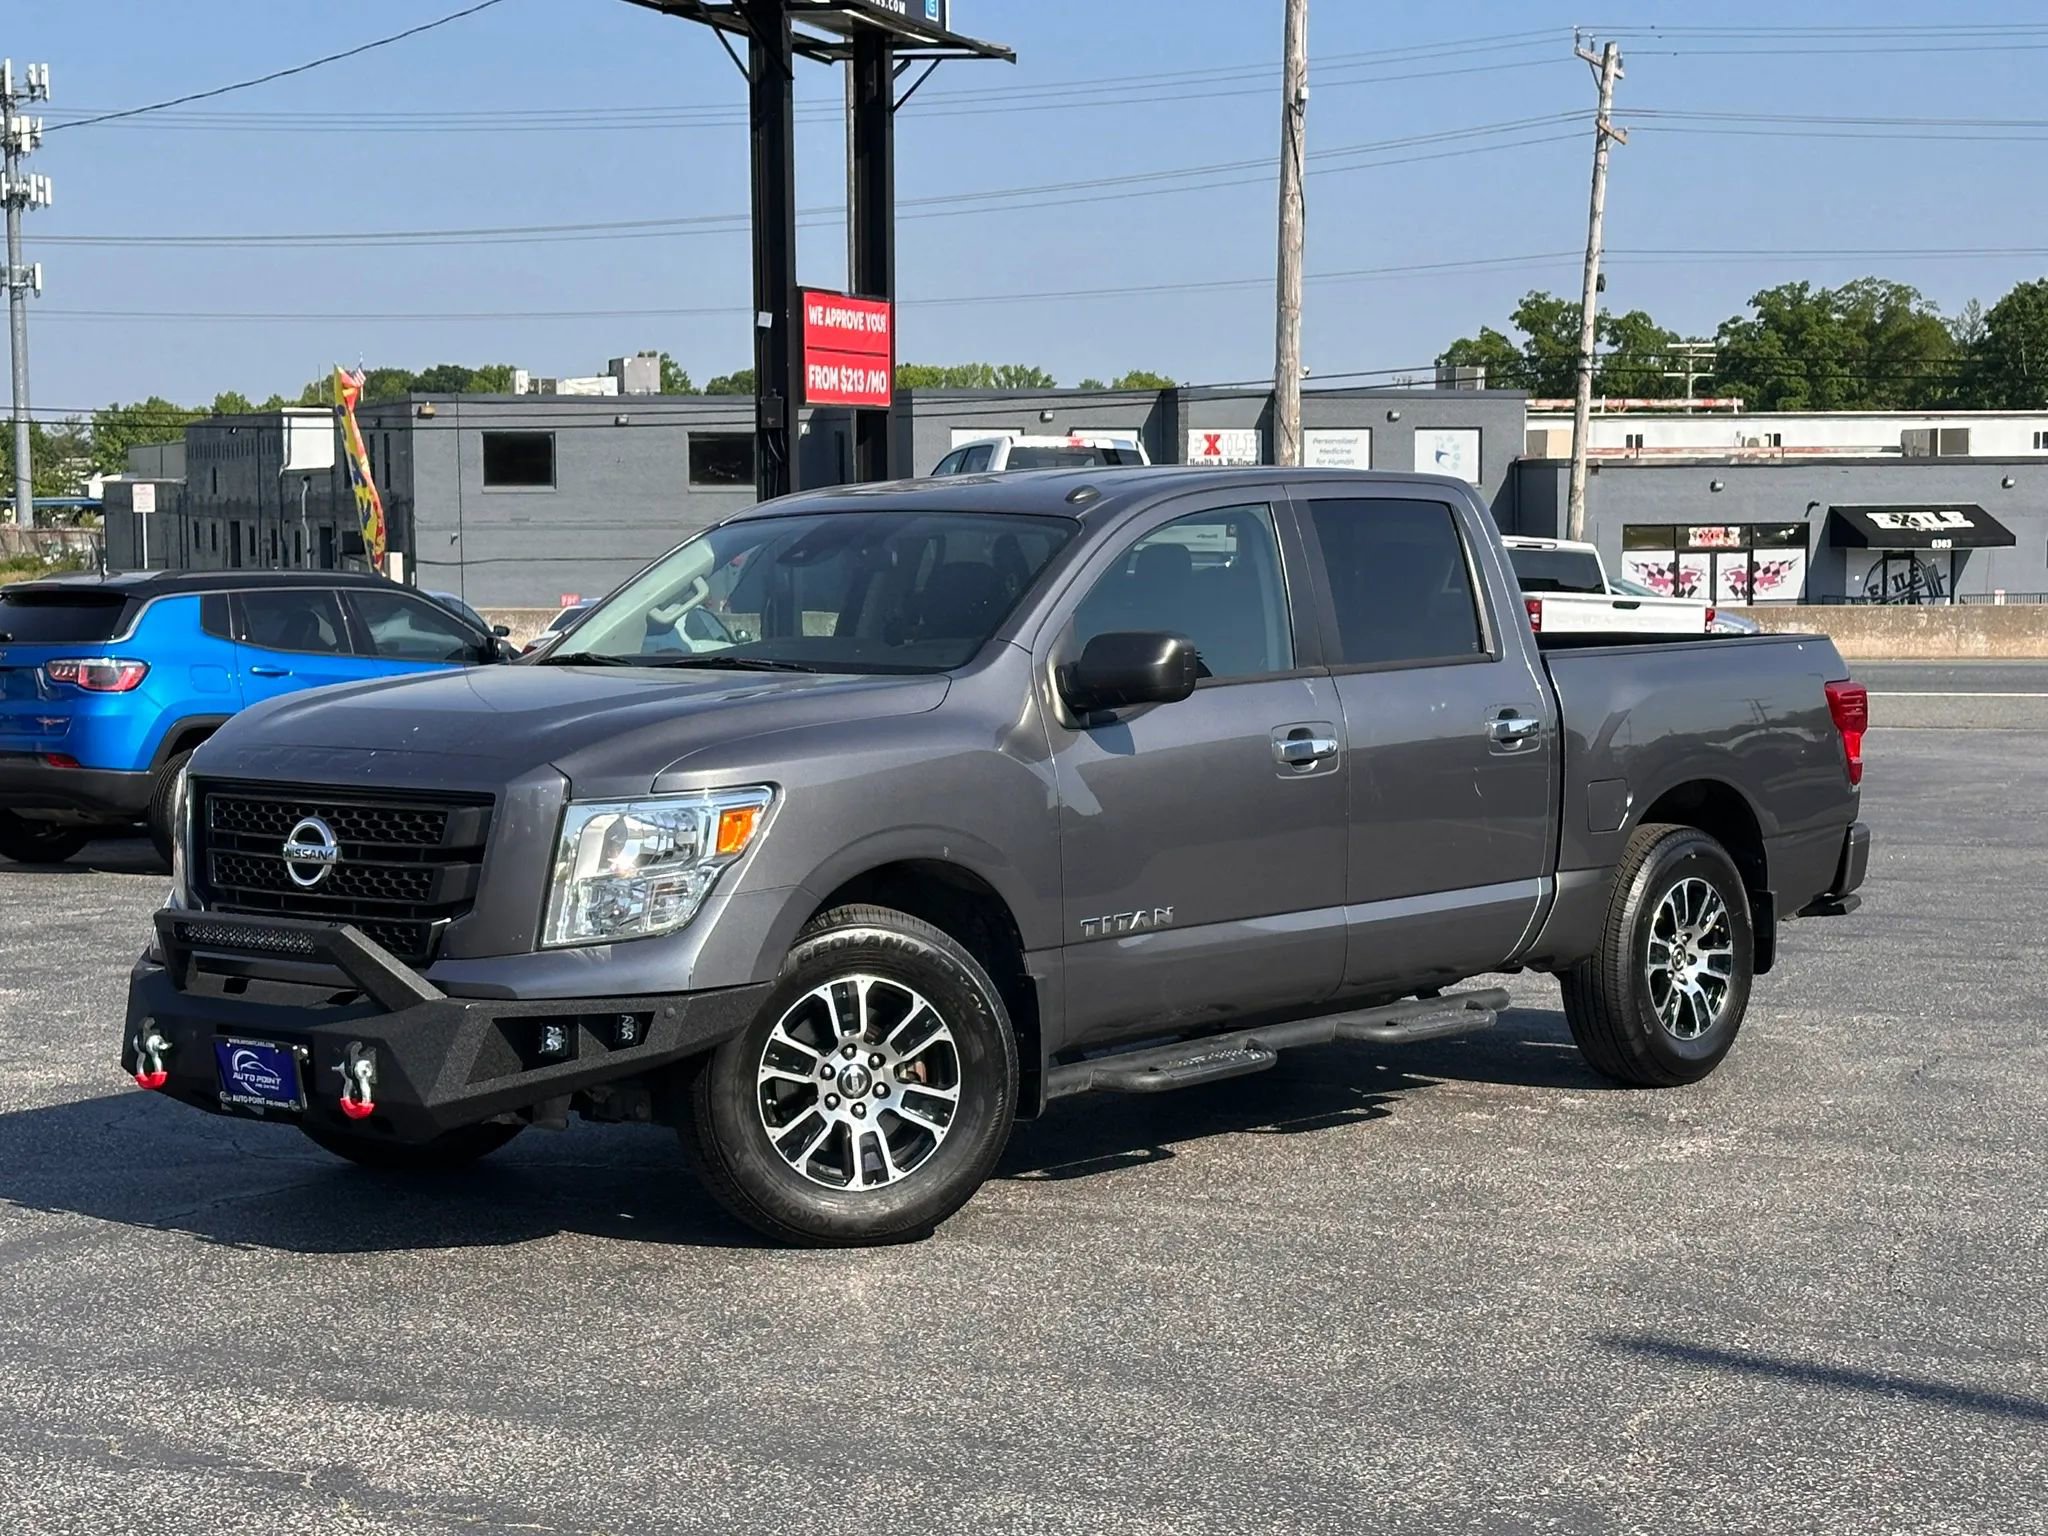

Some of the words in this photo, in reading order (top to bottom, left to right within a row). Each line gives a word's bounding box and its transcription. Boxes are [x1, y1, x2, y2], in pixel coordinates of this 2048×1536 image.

[808, 305, 824, 326] WE
[825, 308, 865, 331] APPROVE
[808, 364, 839, 391] FROM
[840, 365, 865, 394] $213
[866, 369, 887, 394] /MO
[1866, 511, 1975, 529] EXILE
[284, 847, 335, 861] NISSAN
[1080, 906, 1174, 937] TITAN
[232, 1072, 255, 1082] AUTO
[256, 1075, 282, 1085] POINT
[232, 1094, 248, 1103] AUTO
[248, 1096, 266, 1105] POINT
